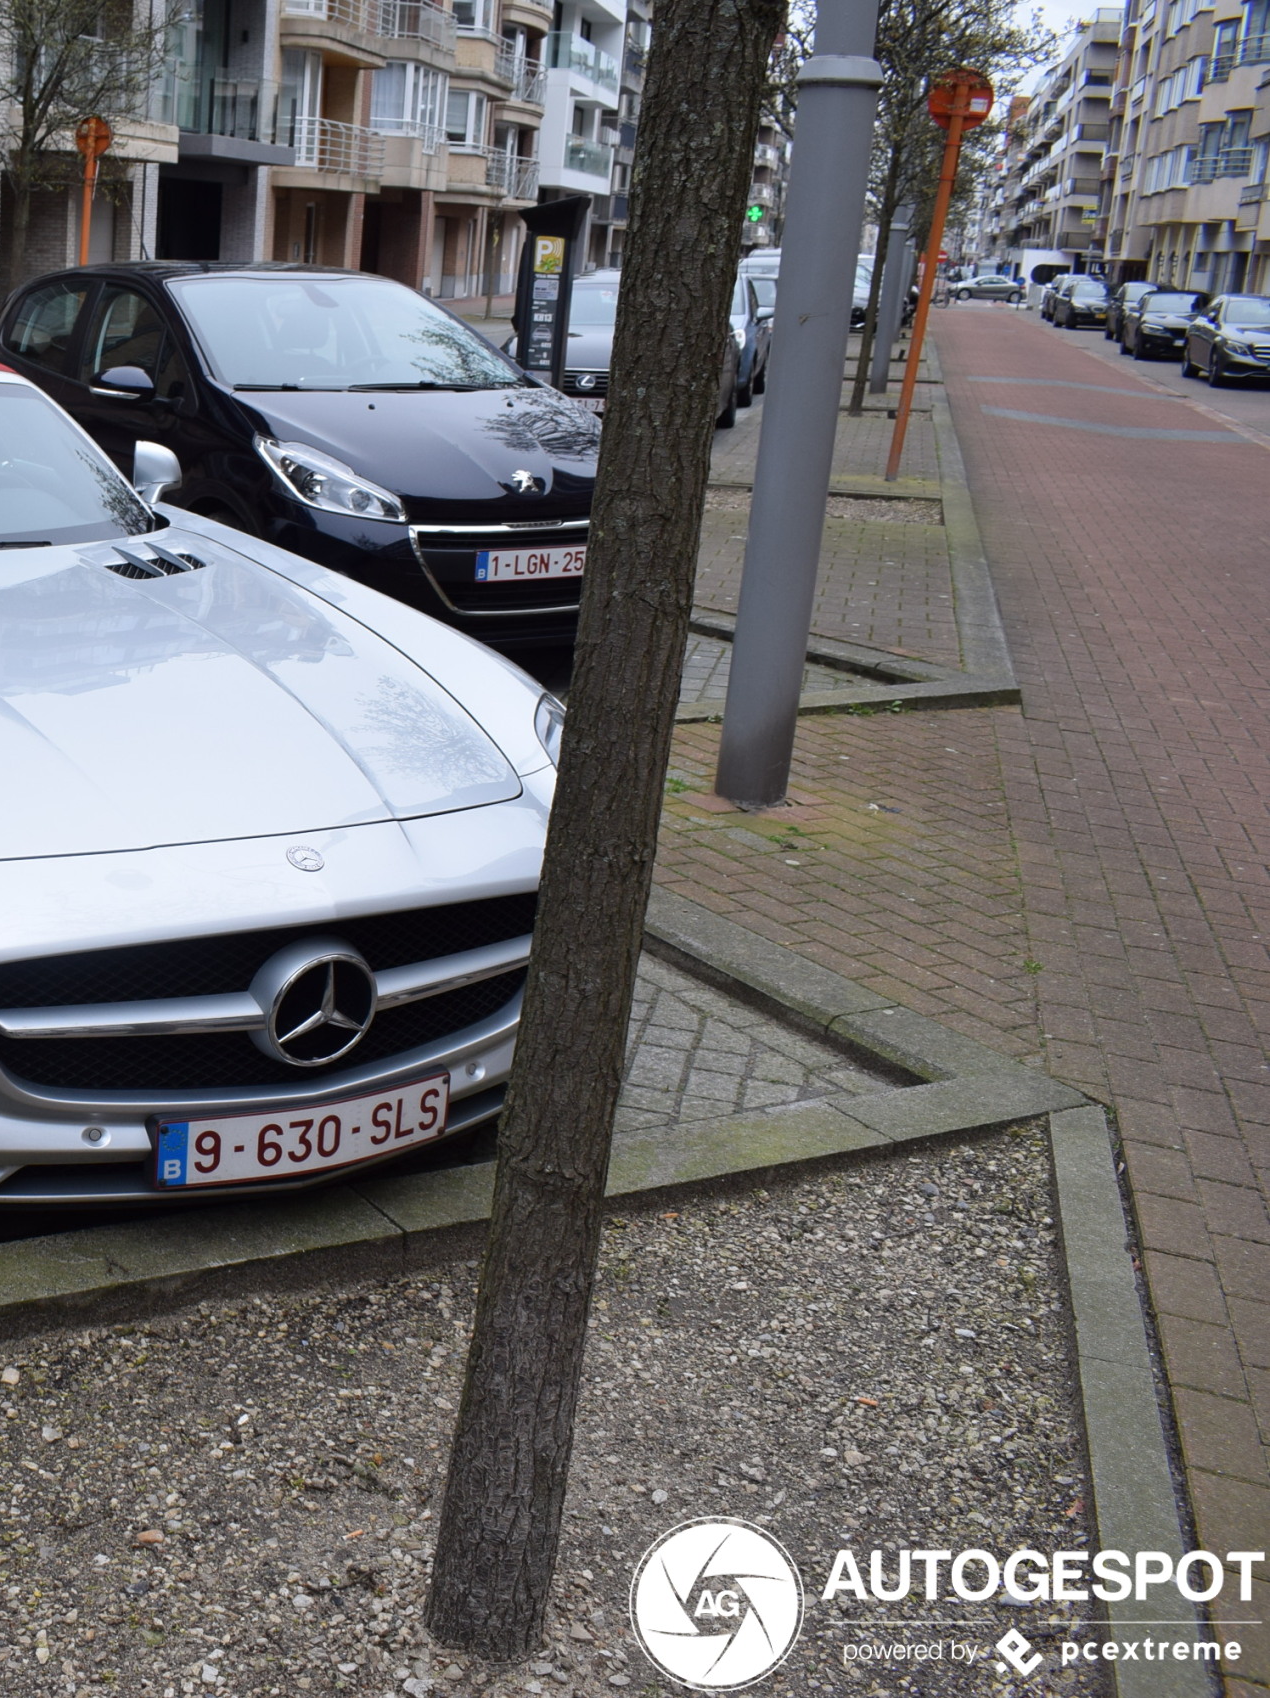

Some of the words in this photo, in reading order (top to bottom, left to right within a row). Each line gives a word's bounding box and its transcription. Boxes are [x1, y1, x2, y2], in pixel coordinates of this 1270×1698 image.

[478, 569, 486, 579] B
[491, 551, 585, 576] 1-LGN-25
[163, 1159, 181, 1179] B
[194, 1088, 440, 1173] 9-630-SLS
